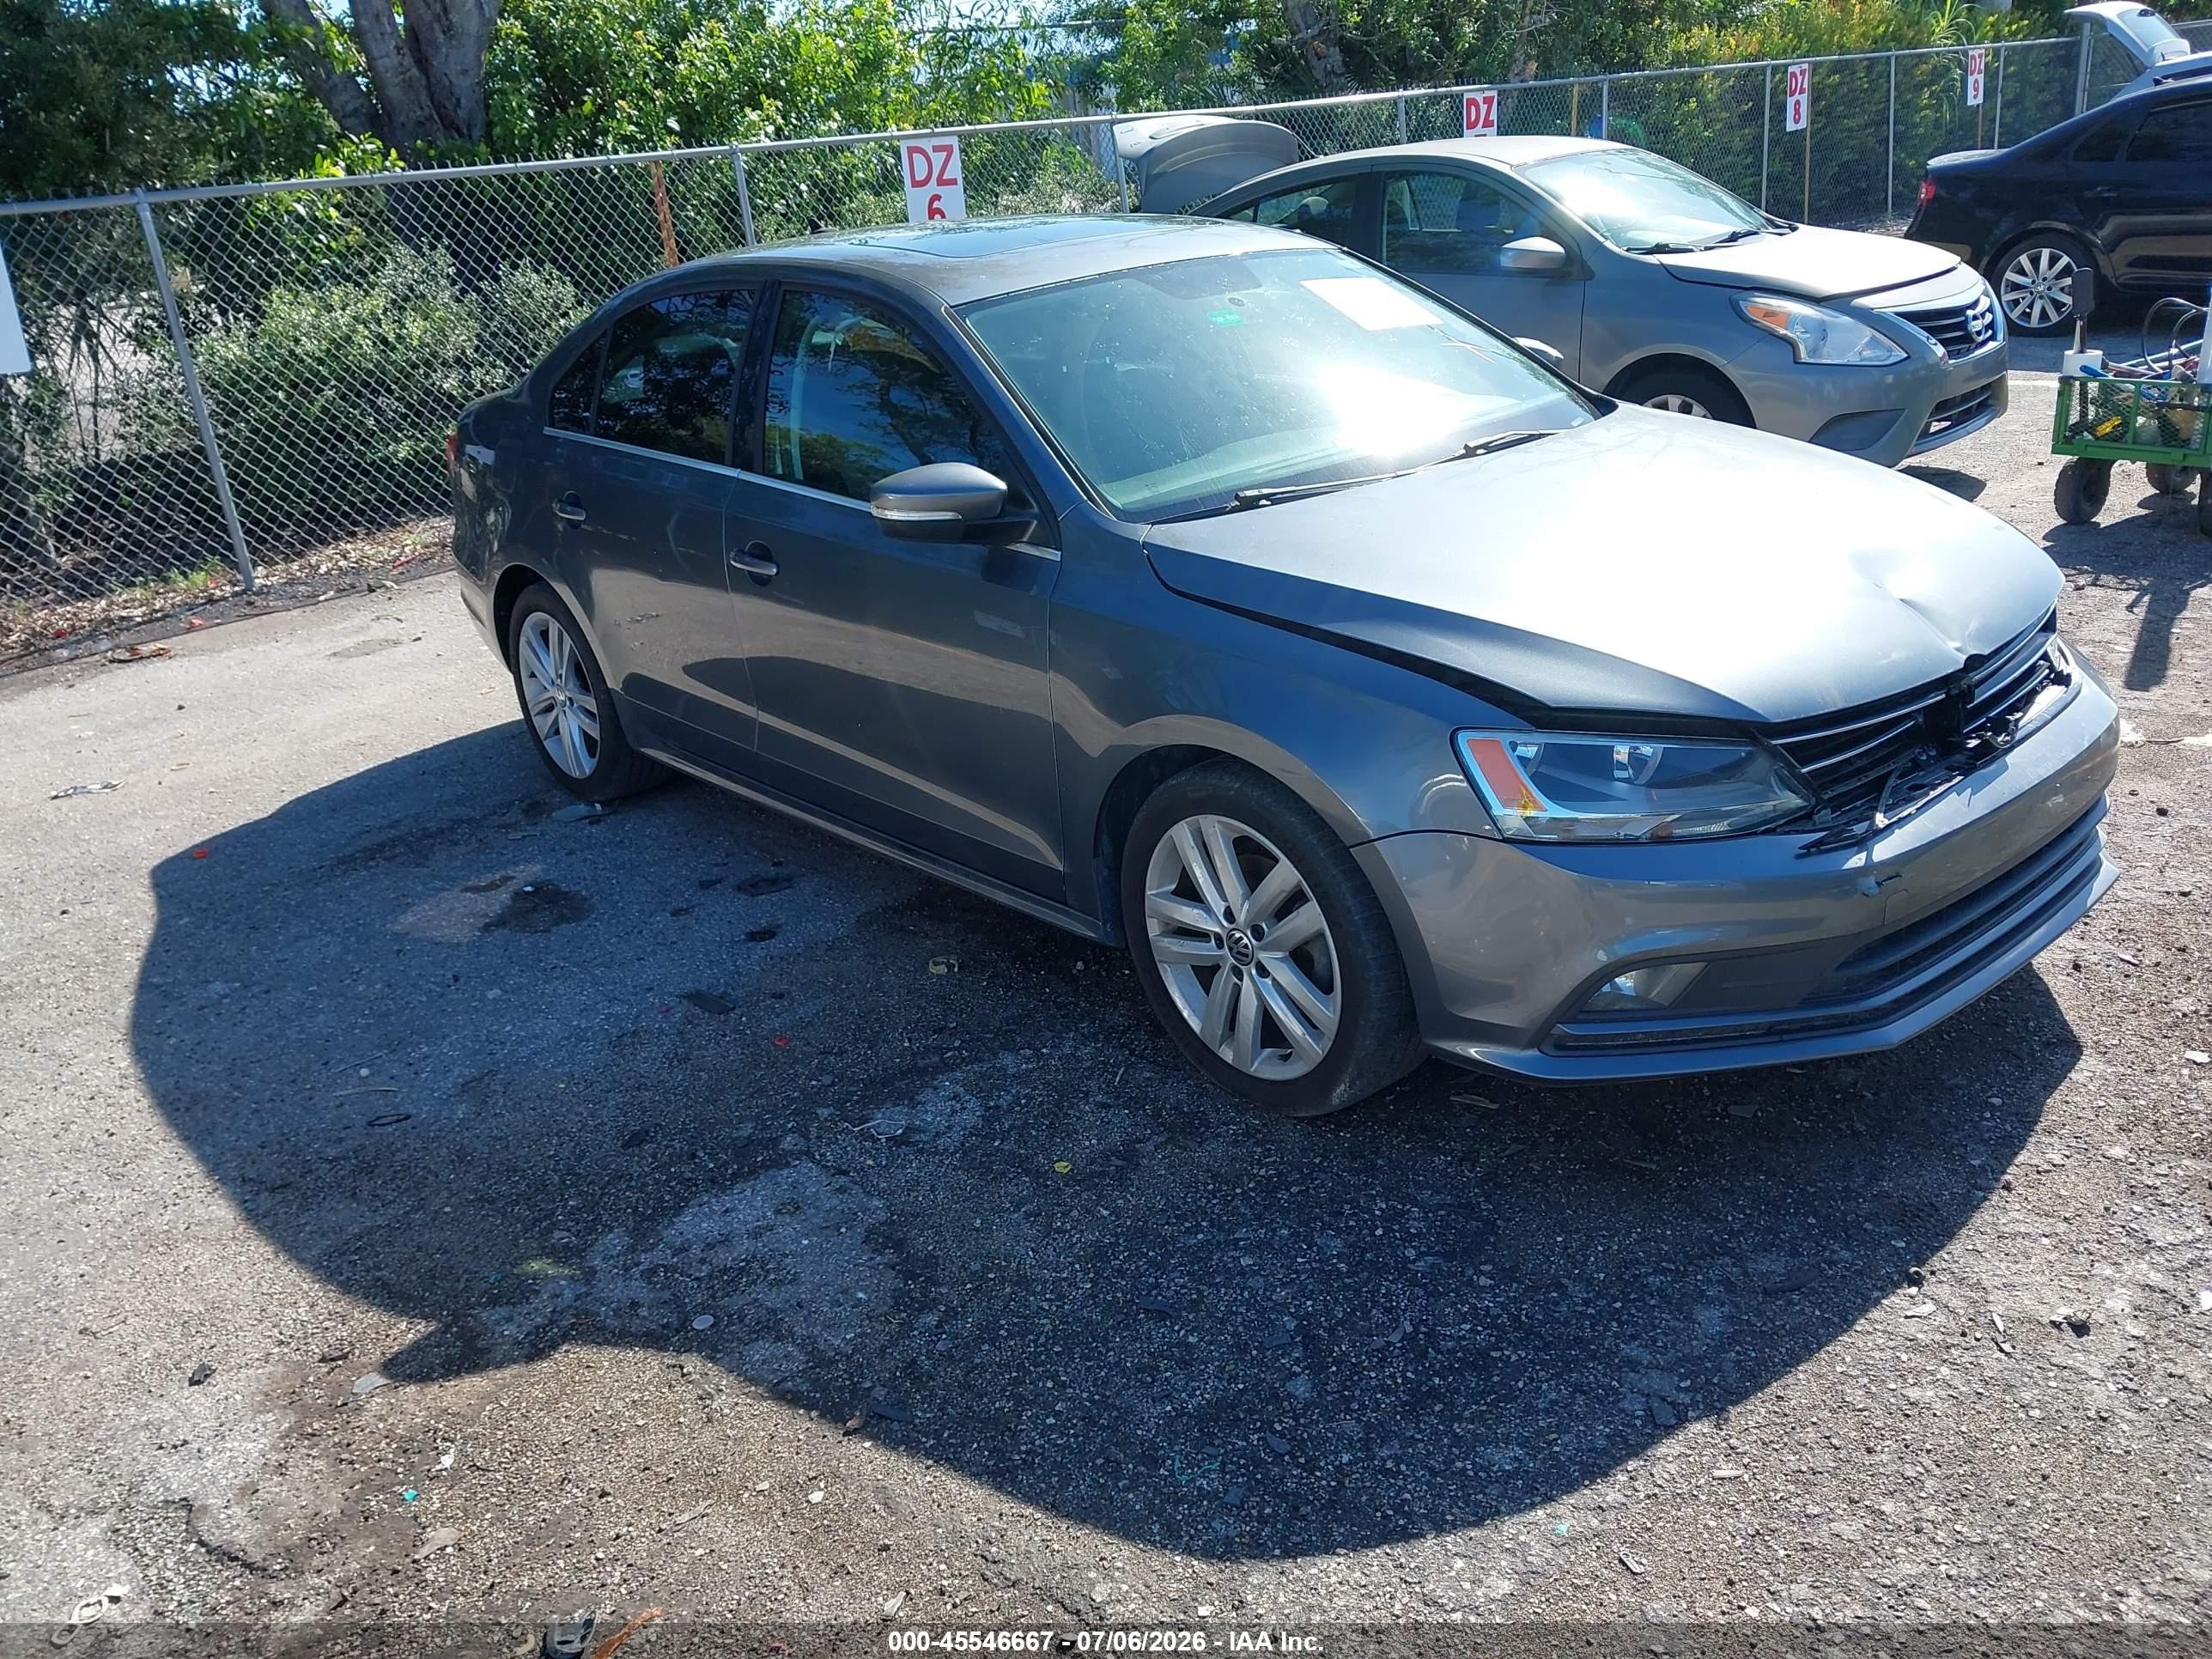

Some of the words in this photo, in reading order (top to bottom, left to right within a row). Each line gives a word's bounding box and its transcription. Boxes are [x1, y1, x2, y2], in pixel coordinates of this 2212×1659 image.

[1969, 52, 1984, 76] DZ
[1789, 69, 1807, 97] DZ
[1972, 78, 1979, 100] 9
[1466, 95, 1495, 130] DZ
[1793, 99, 1801, 125] 8
[907, 144, 957, 188] DZ
[927, 193, 946, 220] 6
